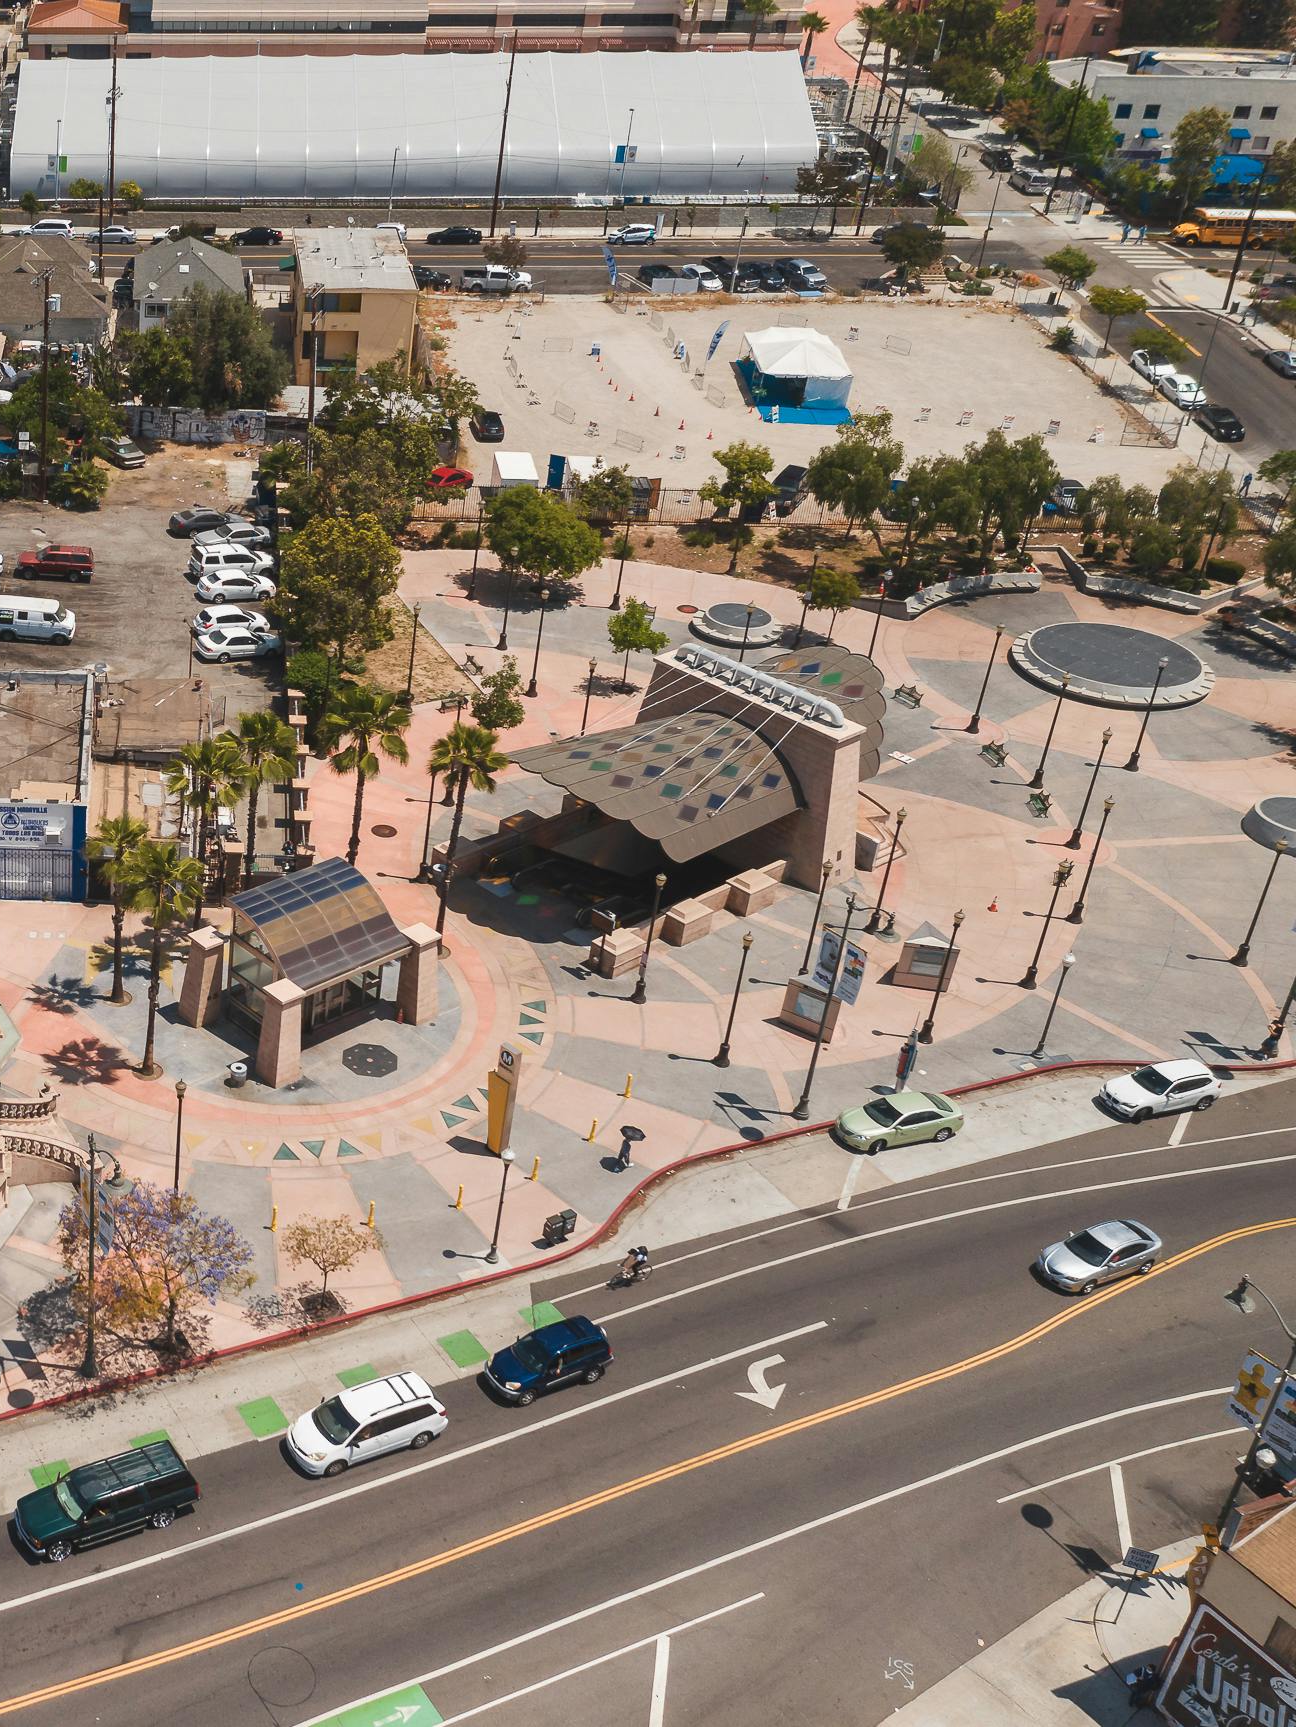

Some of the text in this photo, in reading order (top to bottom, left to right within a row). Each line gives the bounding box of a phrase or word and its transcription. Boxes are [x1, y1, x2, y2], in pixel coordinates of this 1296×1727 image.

[1130, 1549, 1154, 1560] RIGHT
[1130, 1554, 1152, 1565] TURN
[1127, 1560, 1149, 1570] ONLY
